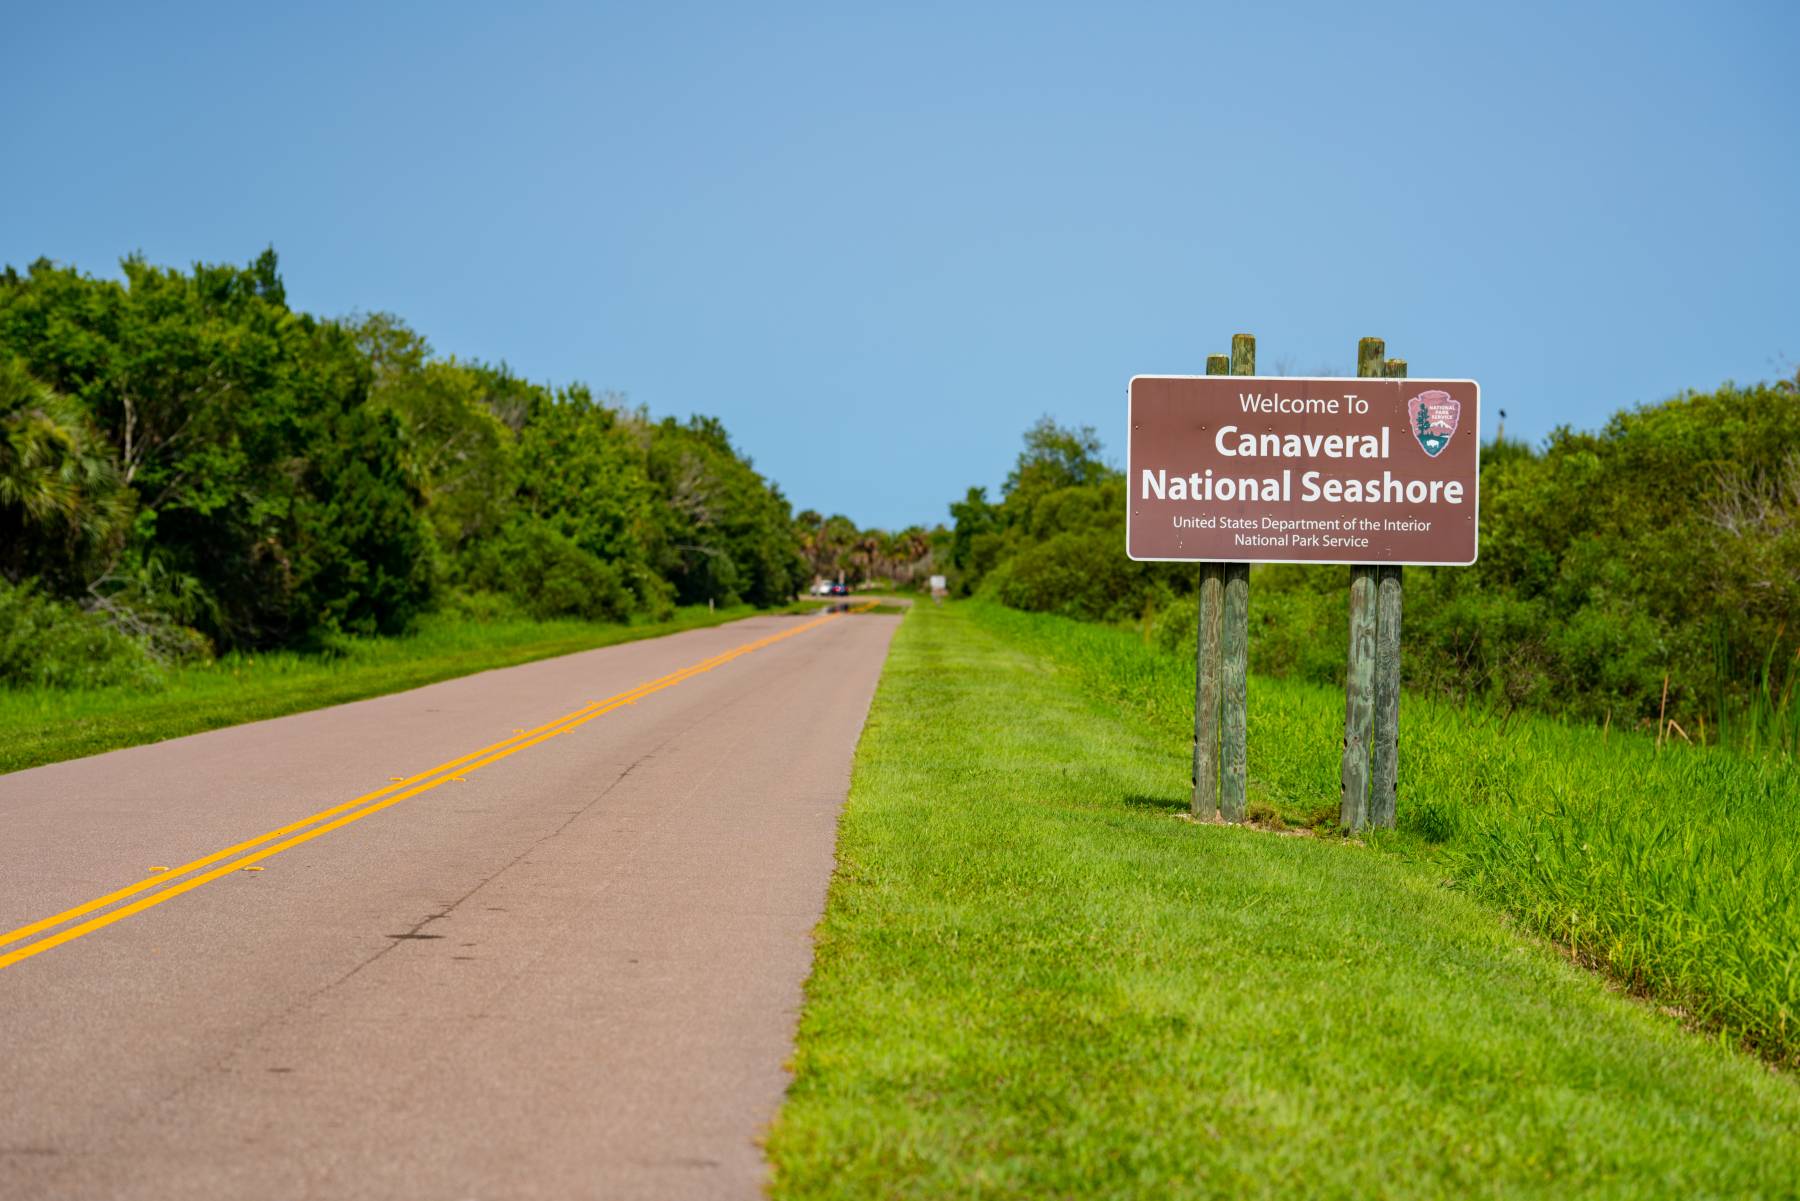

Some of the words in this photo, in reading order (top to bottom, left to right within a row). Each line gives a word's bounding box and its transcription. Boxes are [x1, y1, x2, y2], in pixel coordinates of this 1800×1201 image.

[1240, 393, 1339, 413] Welcome
[1344, 395, 1368, 414] To
[1215, 426, 1389, 458] Canaveral
[1142, 469, 1290, 501] National
[1302, 471, 1463, 504] Seashore
[1173, 516, 1216, 528] United
[1220, 516, 1258, 529] States
[1262, 517, 1340, 532] Department
[1343, 518, 1357, 530] of
[1359, 518, 1380, 531] the
[1384, 519, 1431, 531] Interior
[1235, 534, 1288, 546] National
[1292, 535, 1319, 547] Park
[1323, 535, 1368, 547] Service
